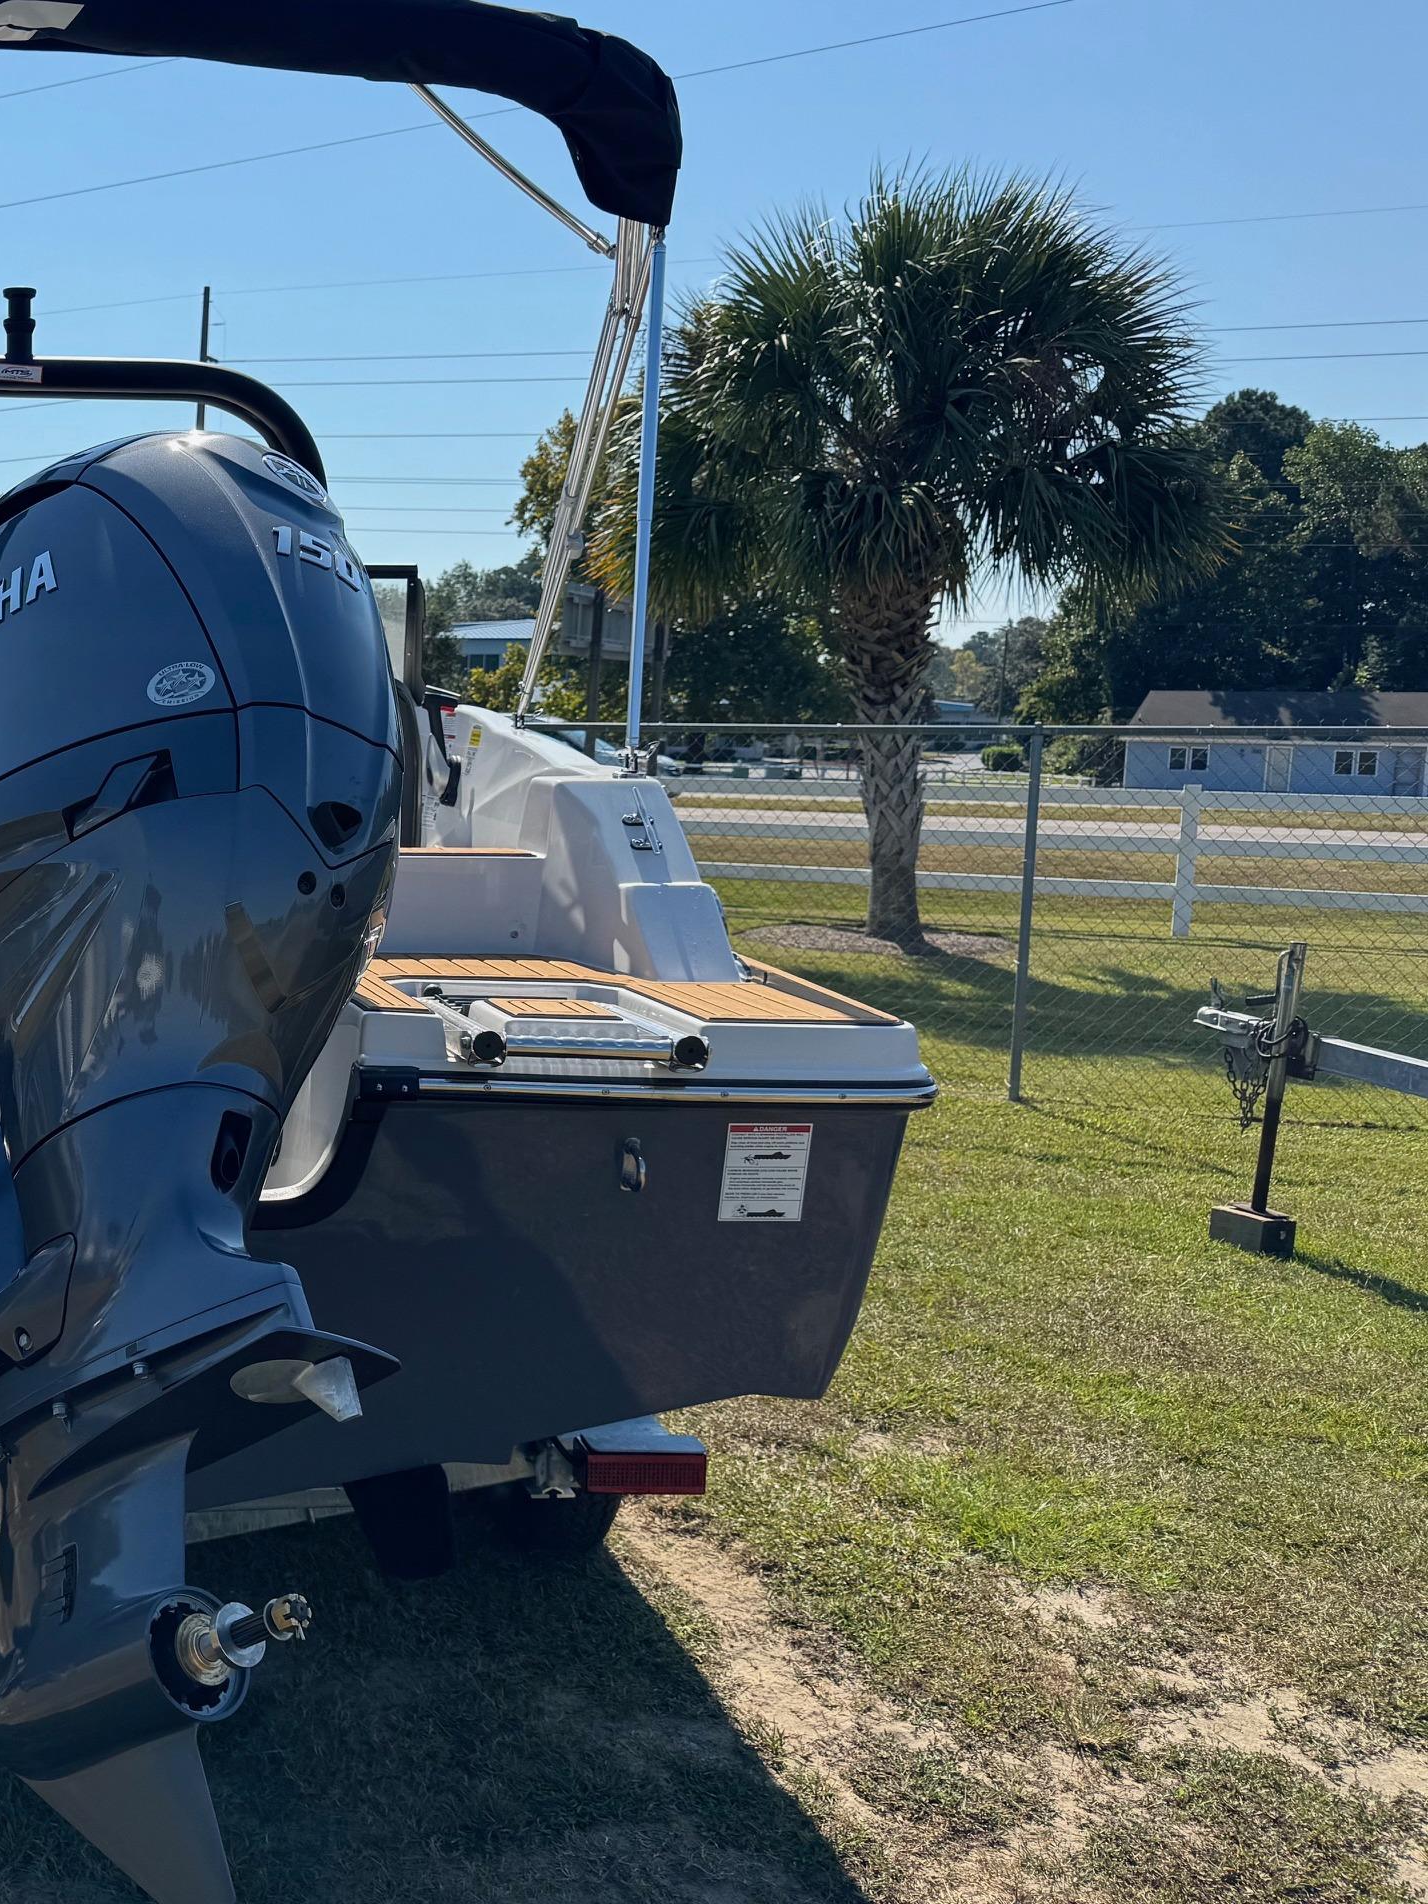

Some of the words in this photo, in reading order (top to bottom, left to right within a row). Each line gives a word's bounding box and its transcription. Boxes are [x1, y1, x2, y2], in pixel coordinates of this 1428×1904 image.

[272, 525, 361, 592] 150
[158, 663, 184, 676] ULTRA
[185, 662, 205, 670] LOW
